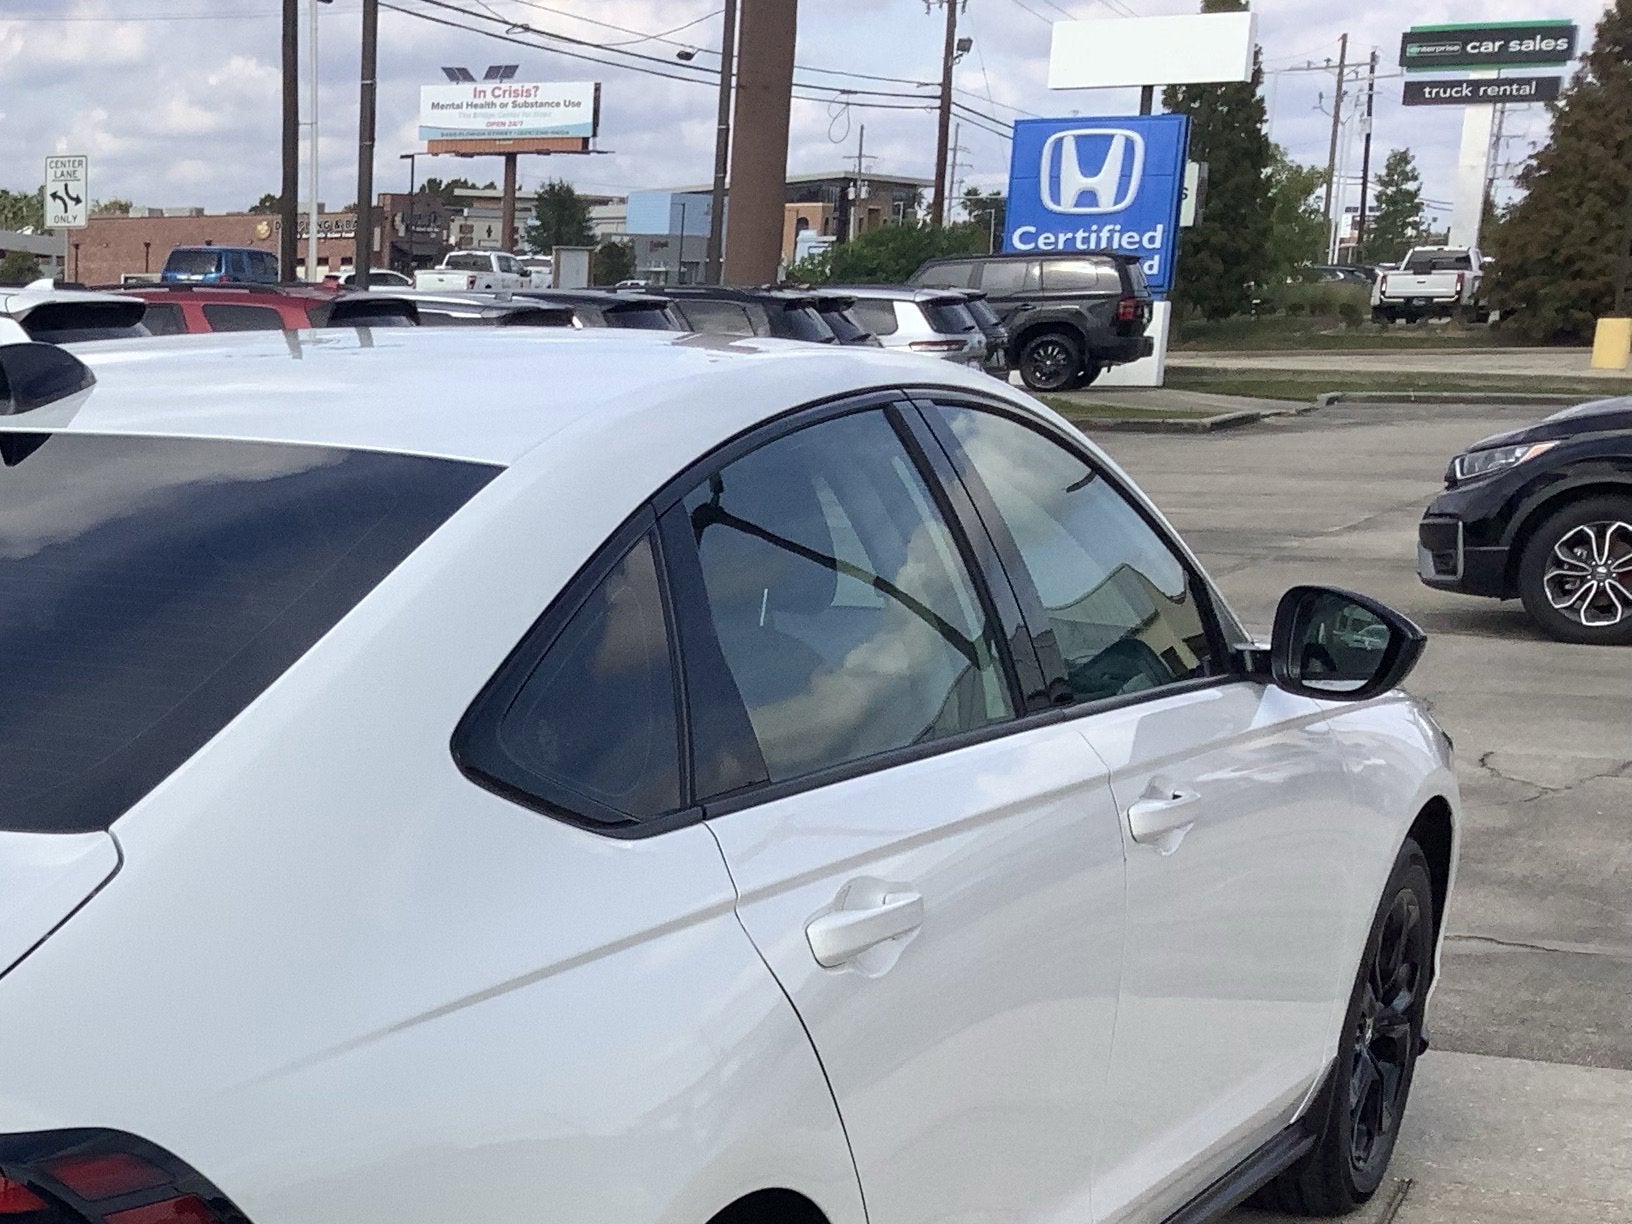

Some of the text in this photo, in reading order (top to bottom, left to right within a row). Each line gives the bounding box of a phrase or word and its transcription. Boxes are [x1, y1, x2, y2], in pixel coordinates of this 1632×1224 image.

[1408, 34, 1569, 54] enterprise car sales
[473, 85, 540, 99] In Crisis?
[1423, 81, 1537, 98] truck rental
[431, 99, 582, 111] Mental Health or Substance Use
[49, 159, 83, 169] CENTER
[54, 170, 78, 179] LANE
[53, 214, 78, 224] ONLY
[335, 219, 344, 229] &
[1011, 223, 1164, 251] Certified
